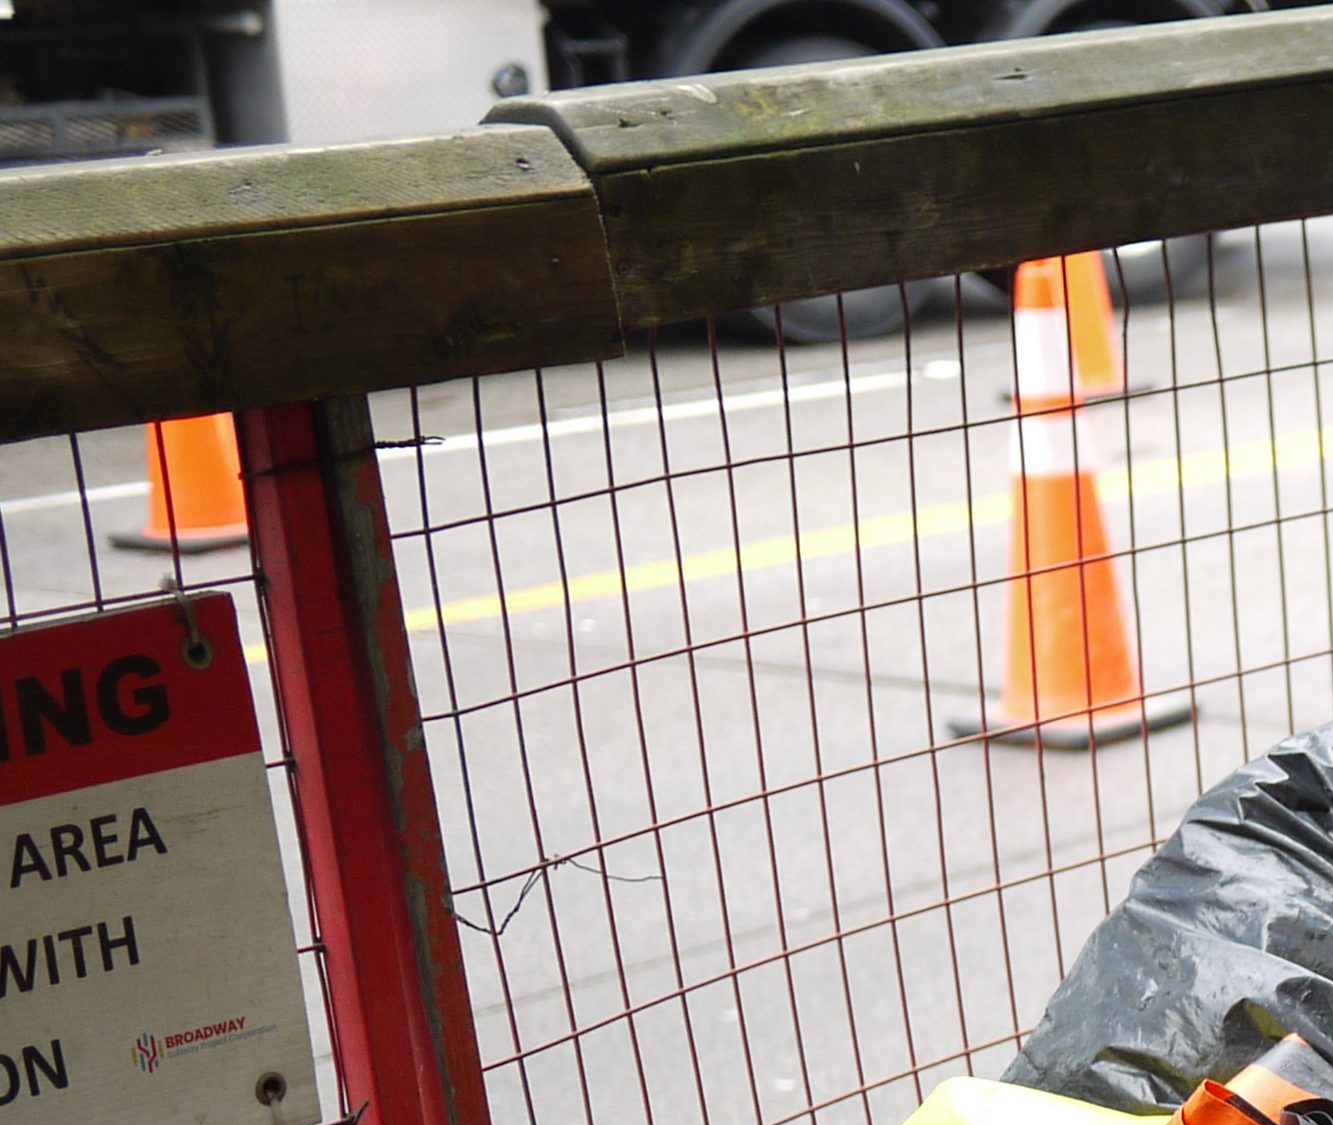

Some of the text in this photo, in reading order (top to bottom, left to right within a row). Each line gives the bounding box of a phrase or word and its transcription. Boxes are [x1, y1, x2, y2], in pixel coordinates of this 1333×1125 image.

[10, 807, 168, 888] AREA
[0, 916, 139, 998] WITH
[164, 1017, 246, 1049] BROADWAY
